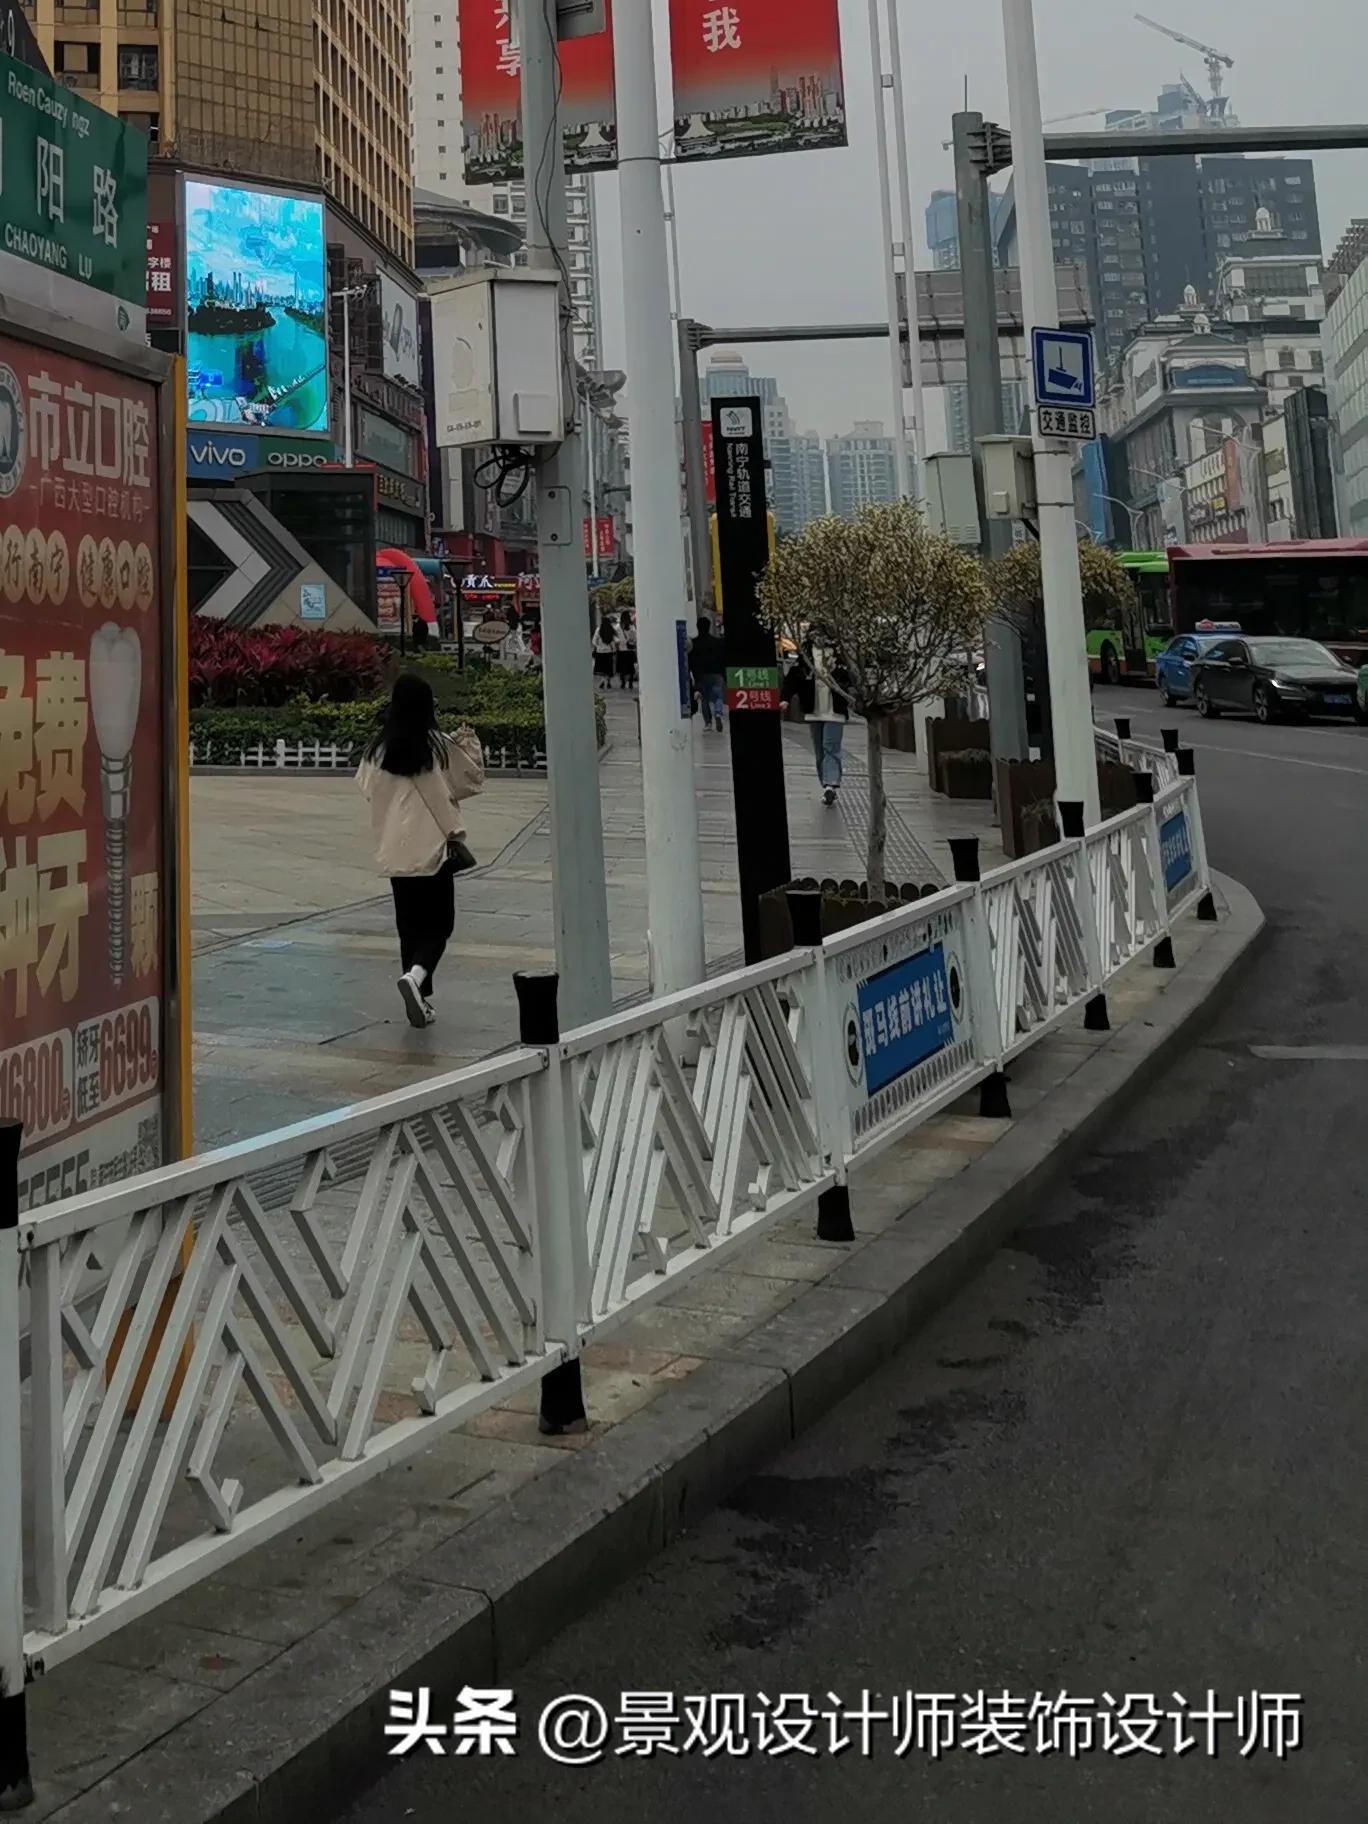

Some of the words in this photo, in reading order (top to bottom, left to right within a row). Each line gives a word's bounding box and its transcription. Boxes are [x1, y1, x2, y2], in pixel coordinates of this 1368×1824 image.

[5, 223, 68, 269] CHAOYANG
[79, 253, 92, 280] LU
[27, 370, 151, 487] 市立口腔
[1042, 410, 1091, 434] 交通监控
[190, 441, 246, 467] vivo
[735, 443, 752, 518] 南宁轨道交通
